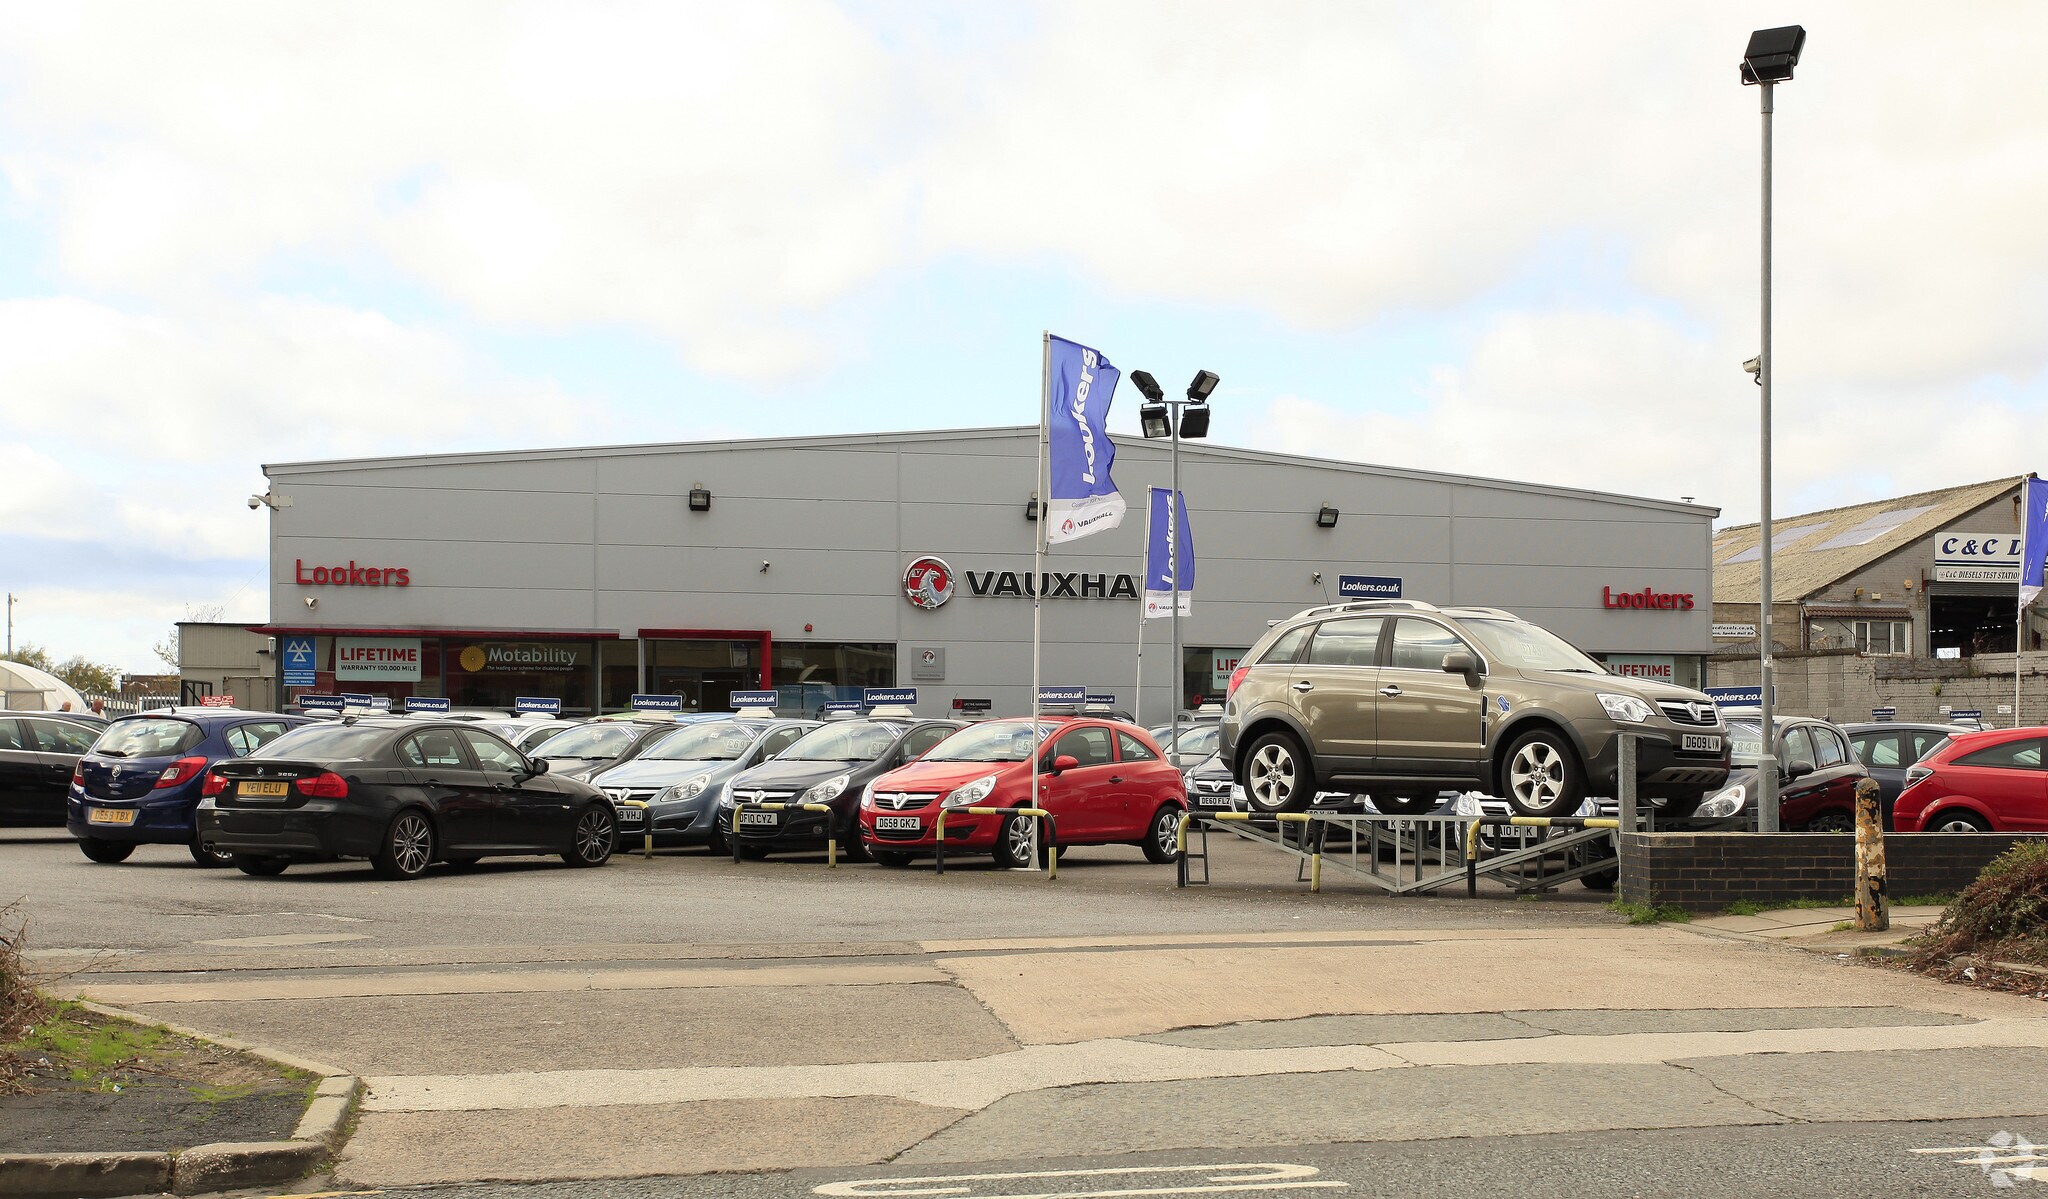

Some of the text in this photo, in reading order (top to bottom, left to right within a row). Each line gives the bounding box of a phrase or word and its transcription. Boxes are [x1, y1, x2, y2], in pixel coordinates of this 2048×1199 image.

[1071, 348, 1097, 486] Lookers
[1077, 511, 1113, 528] VAUXHALL
[2006, 539, 2021, 556] D
[295, 558, 410, 587] Lookers
[1958, 570, 1982, 579] DIESELS
[1982, 571, 1998, 579] TEST
[1997, 571, 2020, 580] STATIO
[964, 569, 1144, 599] VAUXHA
[1341, 581, 1400, 593] Lookers.co.uk
[1603, 585, 1695, 610] Lookers
[340, 647, 417, 662] LIFETIME
[488, 647, 578, 666] Motability
[377, 664, 401, 672] 100,000
[1216, 658, 1239, 671] LIF
[732, 695, 776, 704] Lookers.co.uk
[866, 690, 915, 701] Lookers.co.uk
[1038, 691, 1084, 699] ookers.co.uk
[407, 701, 449, 709] Lookers.co.uk
[517, 701, 558, 710] Lookers.co.uk
[633, 699, 680, 708] Lookers.co.uk
[1685, 735, 1707, 749] DG09
[263, 783, 282, 794] ELU
[115, 810, 131, 821] TBX
[625, 809, 642, 820] VHJ
[756, 814, 773, 824] CYZ
[879, 818, 917, 828] DG58 GKZ
[1513, 826, 1533, 836] FK
